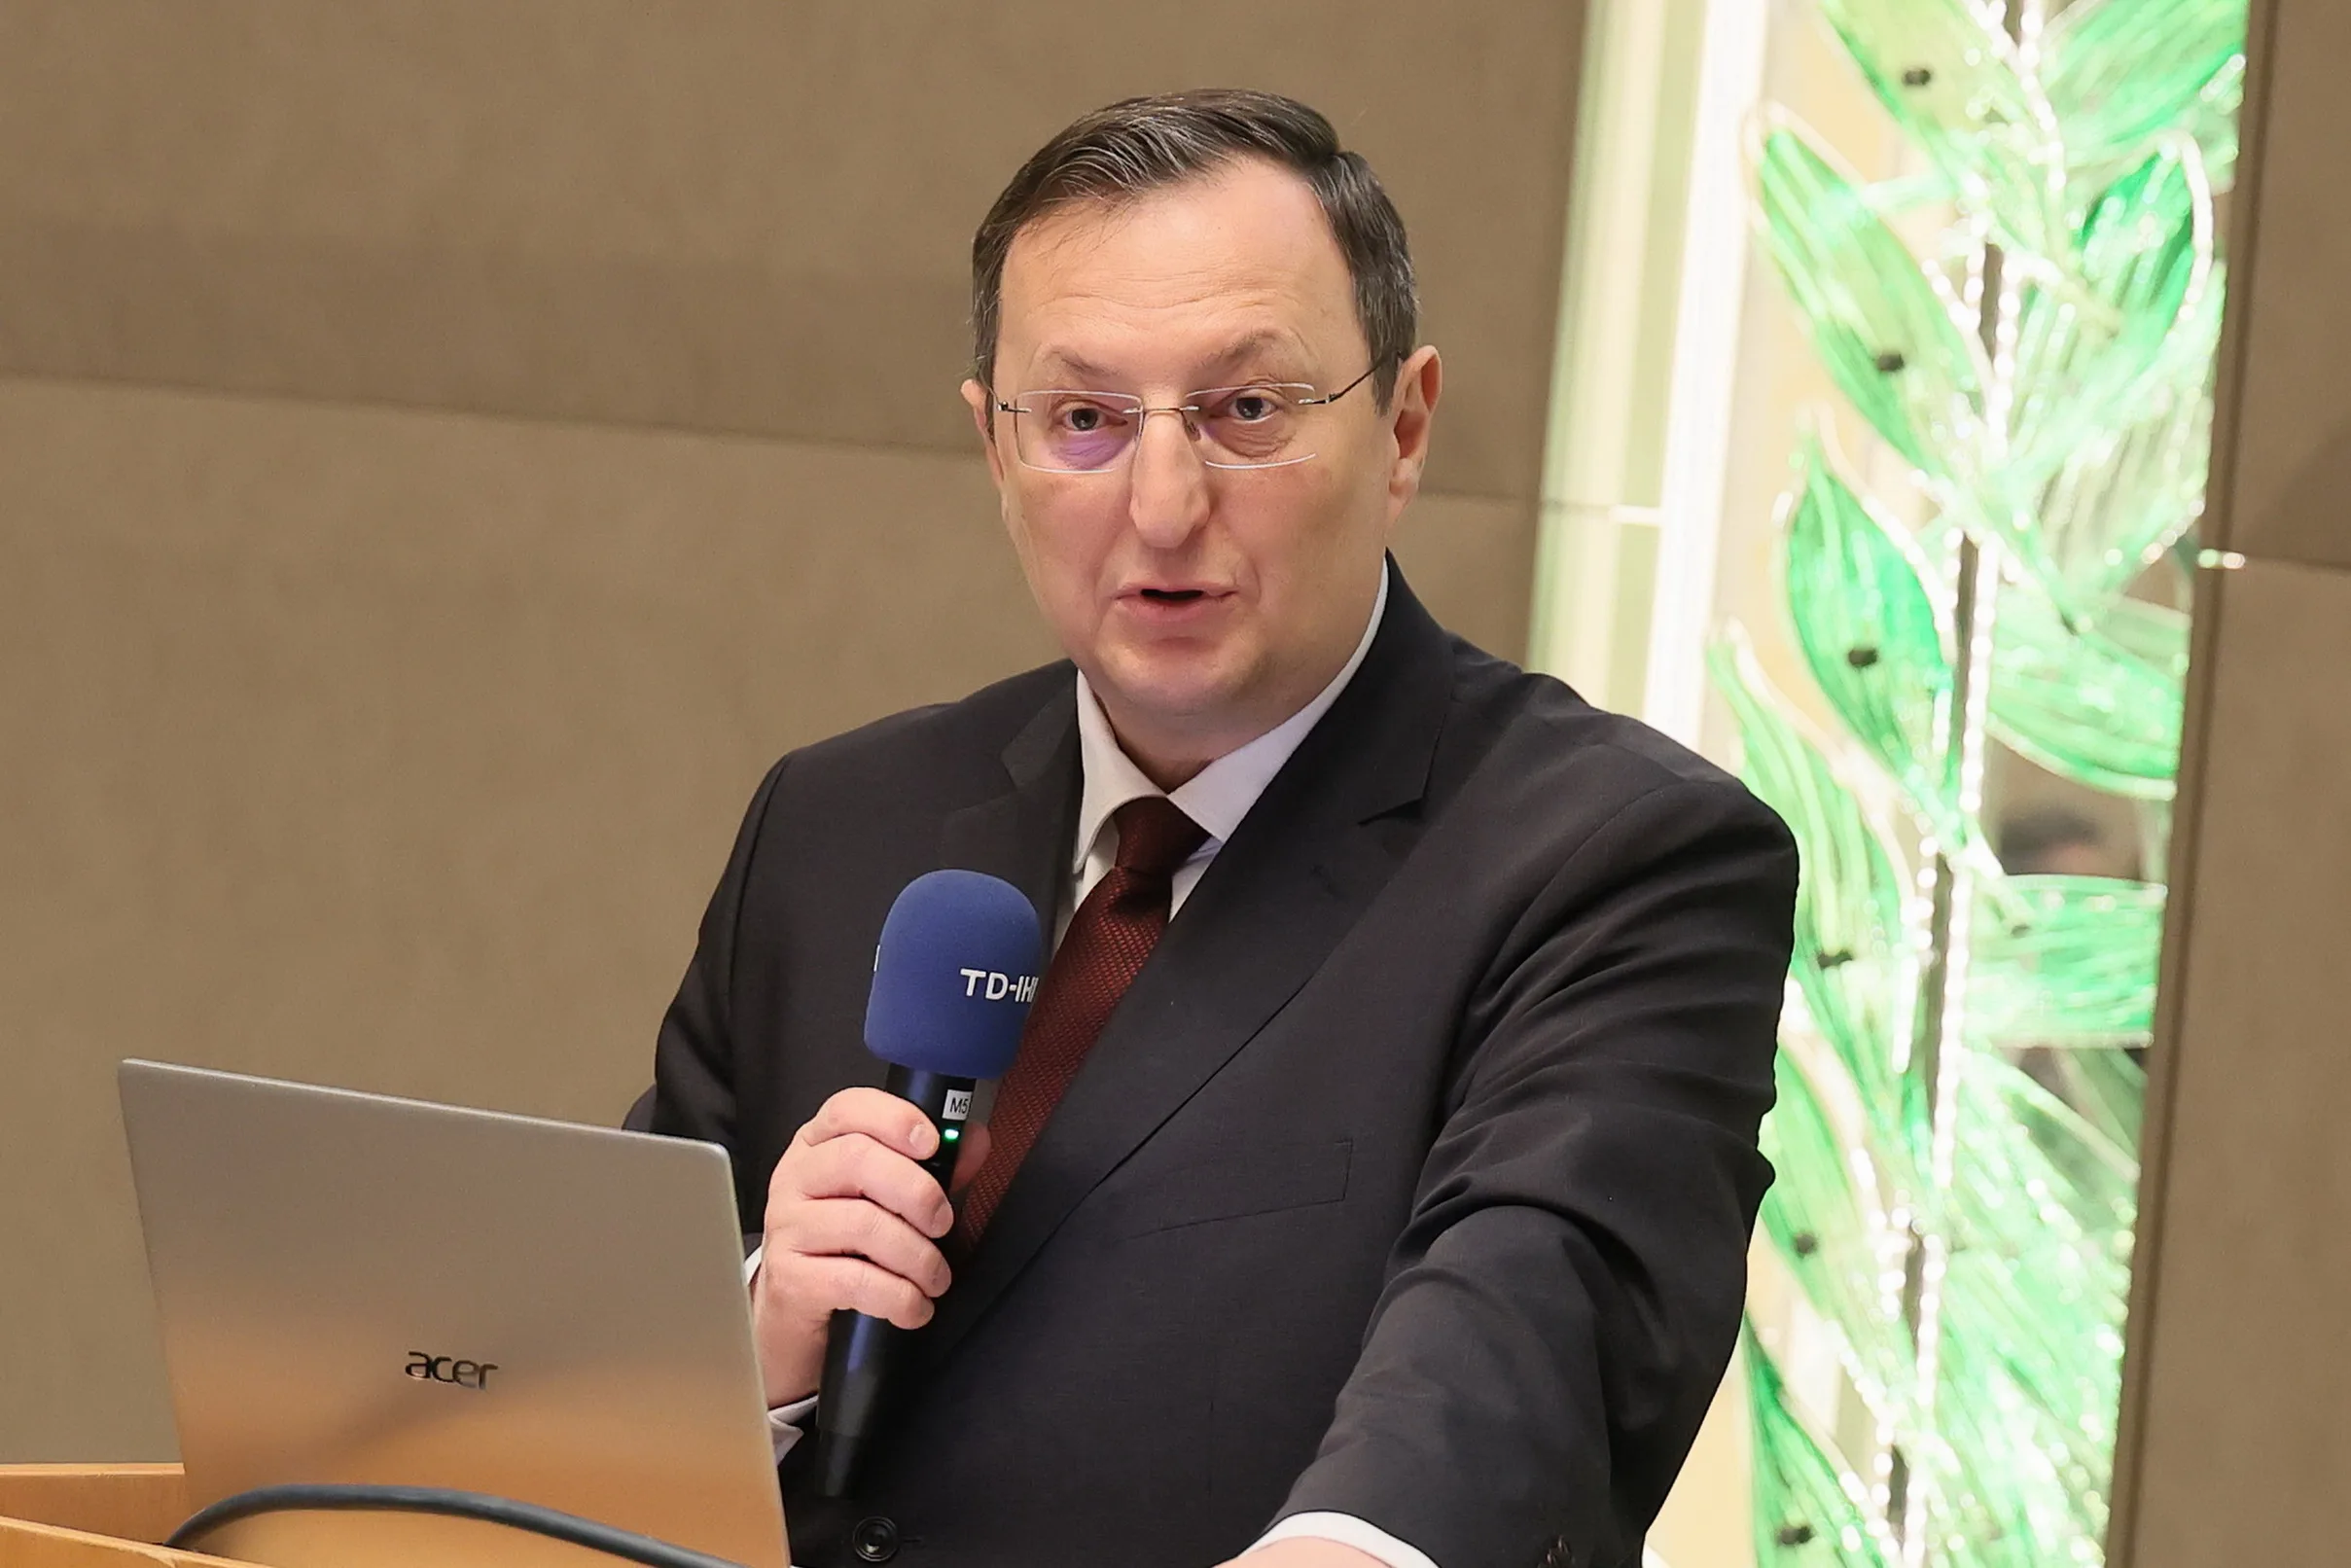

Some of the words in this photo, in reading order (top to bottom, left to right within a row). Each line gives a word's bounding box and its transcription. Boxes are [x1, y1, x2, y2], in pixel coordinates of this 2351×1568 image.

[960, 968, 1040, 1003] TD-IH
[949, 1096, 969, 1115] M5
[405, 1351, 499, 1390] acer
